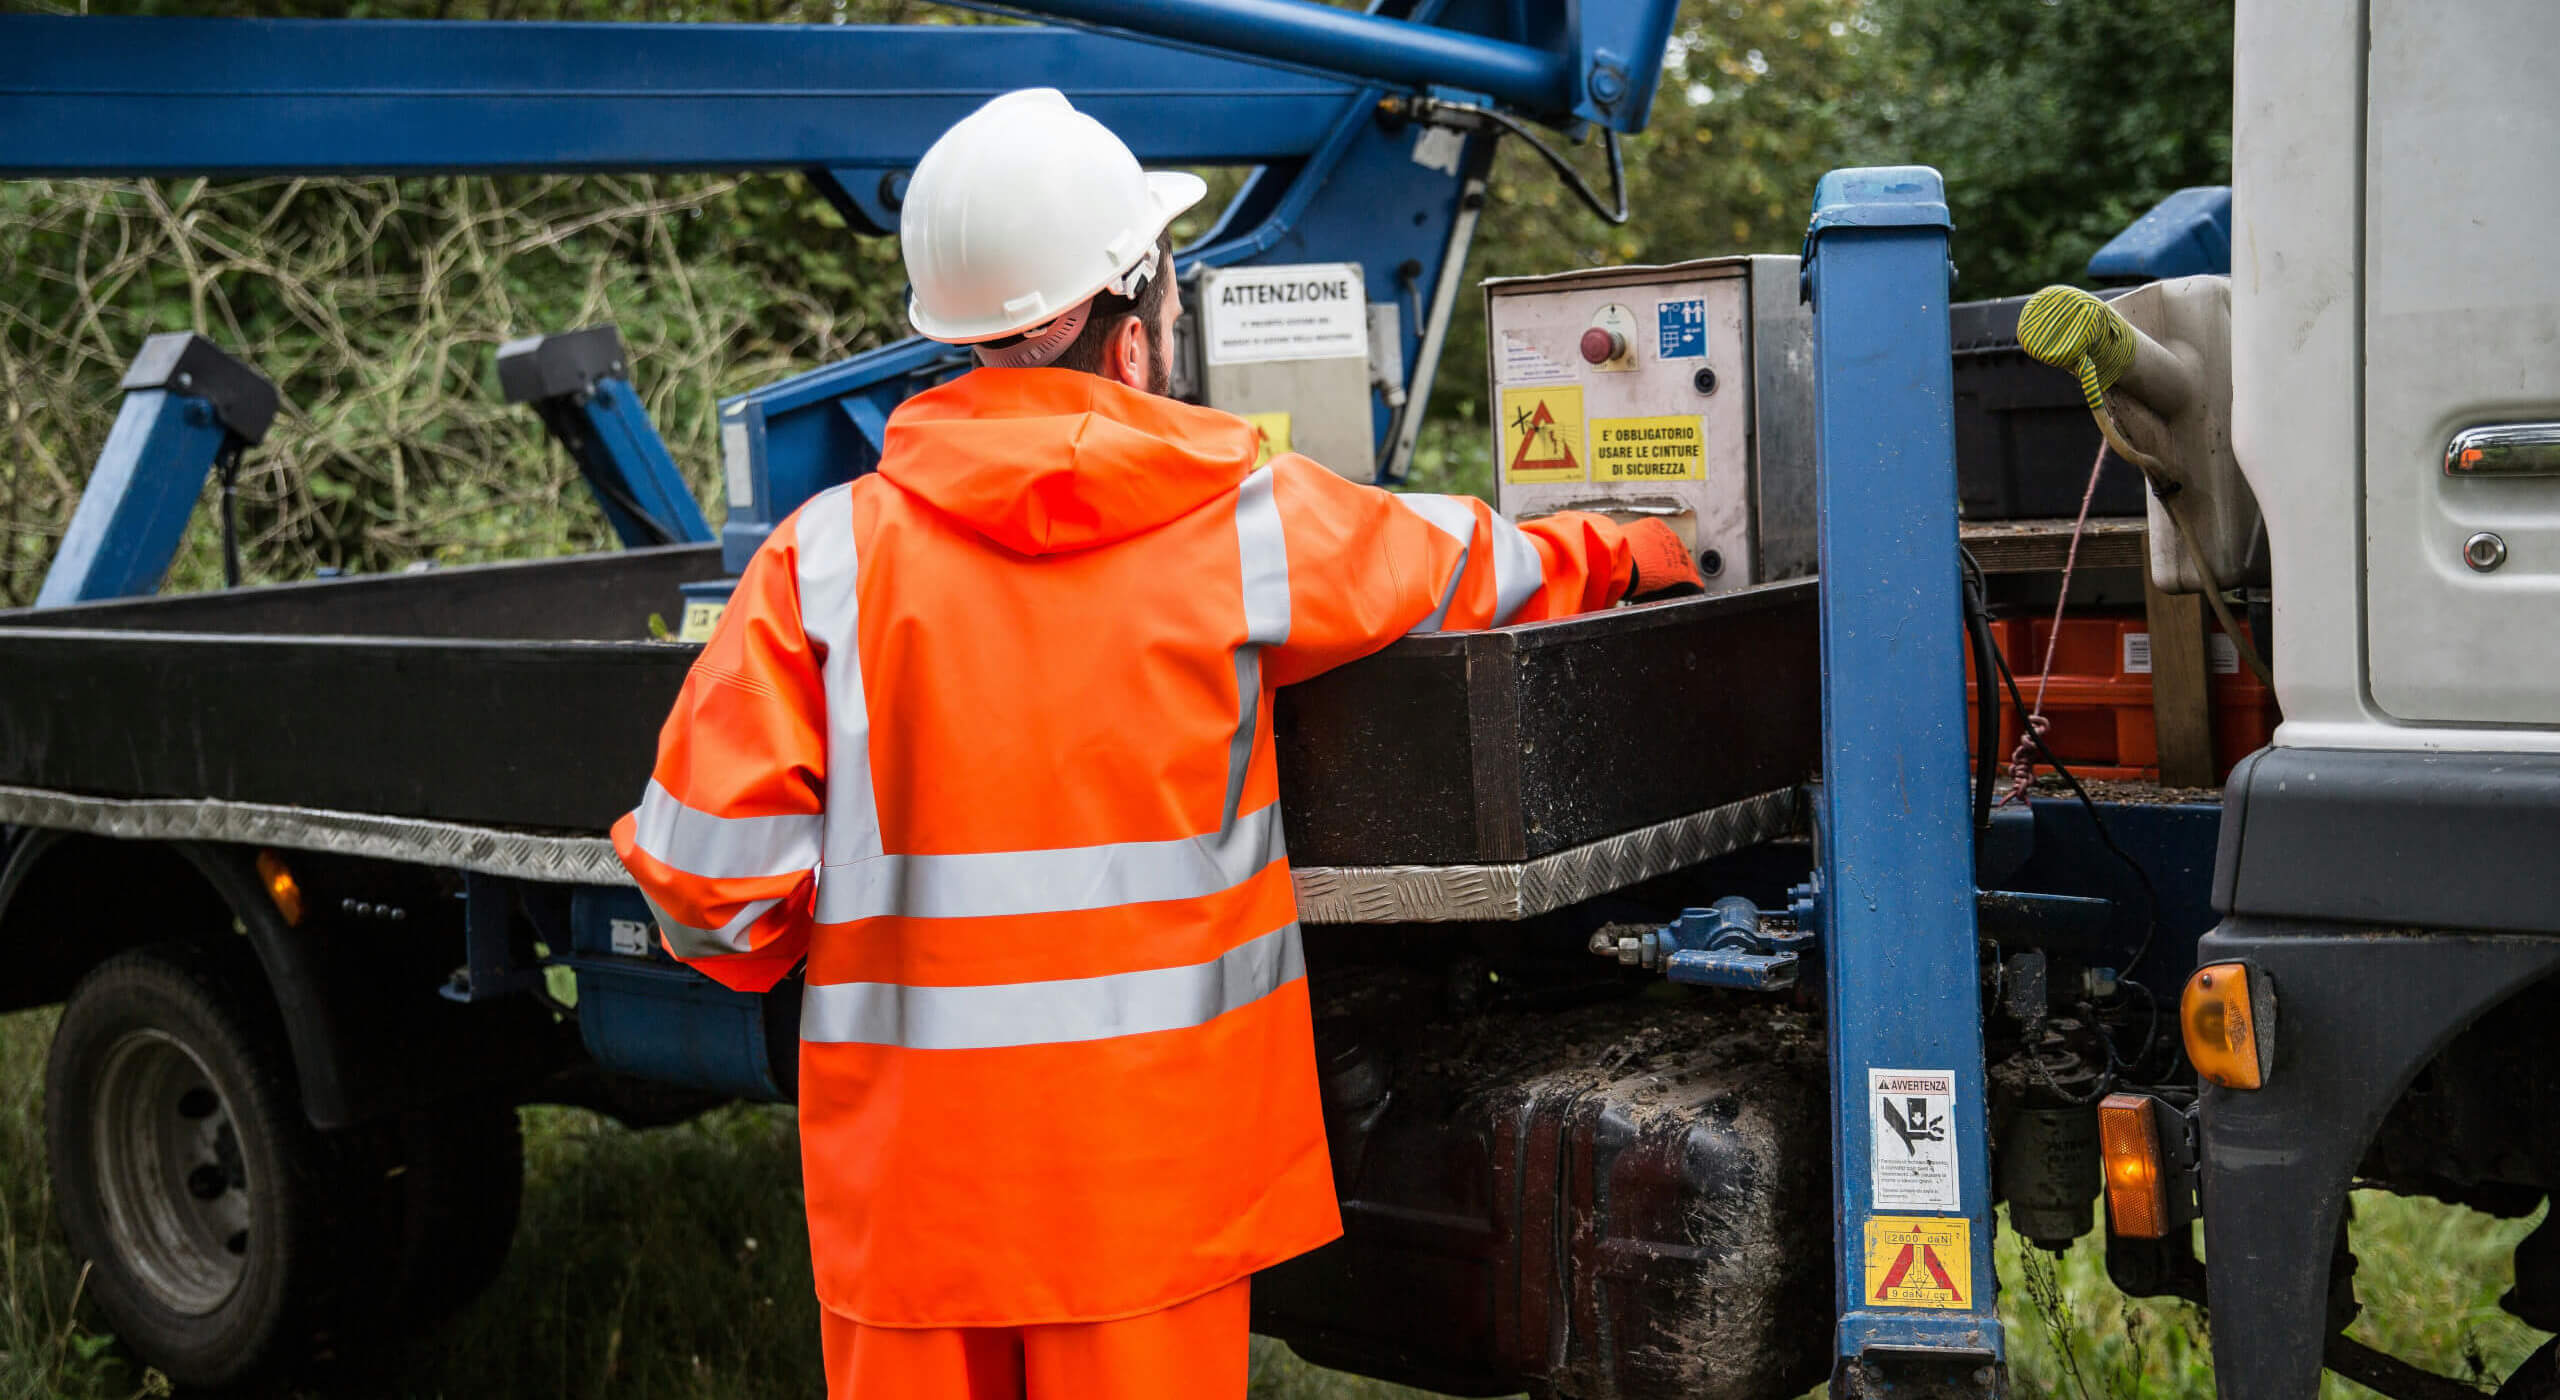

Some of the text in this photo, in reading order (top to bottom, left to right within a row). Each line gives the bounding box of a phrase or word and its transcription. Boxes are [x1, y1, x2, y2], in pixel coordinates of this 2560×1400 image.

[1223, 282, 1349, 305] ATTENZIONE
[1616, 428, 1694, 441] OBBLIGATORIO
[1598, 444, 1699, 459] USARE LE CINTURE
[1612, 462, 1685, 476] DI SICUREZZA
[1892, 1080, 1947, 1092] AVVERTENZA
[1892, 1234, 1918, 1242] 2800
[1892, 1290, 1898, 1298] 9
[1903, 1290, 1922, 1298] daN
